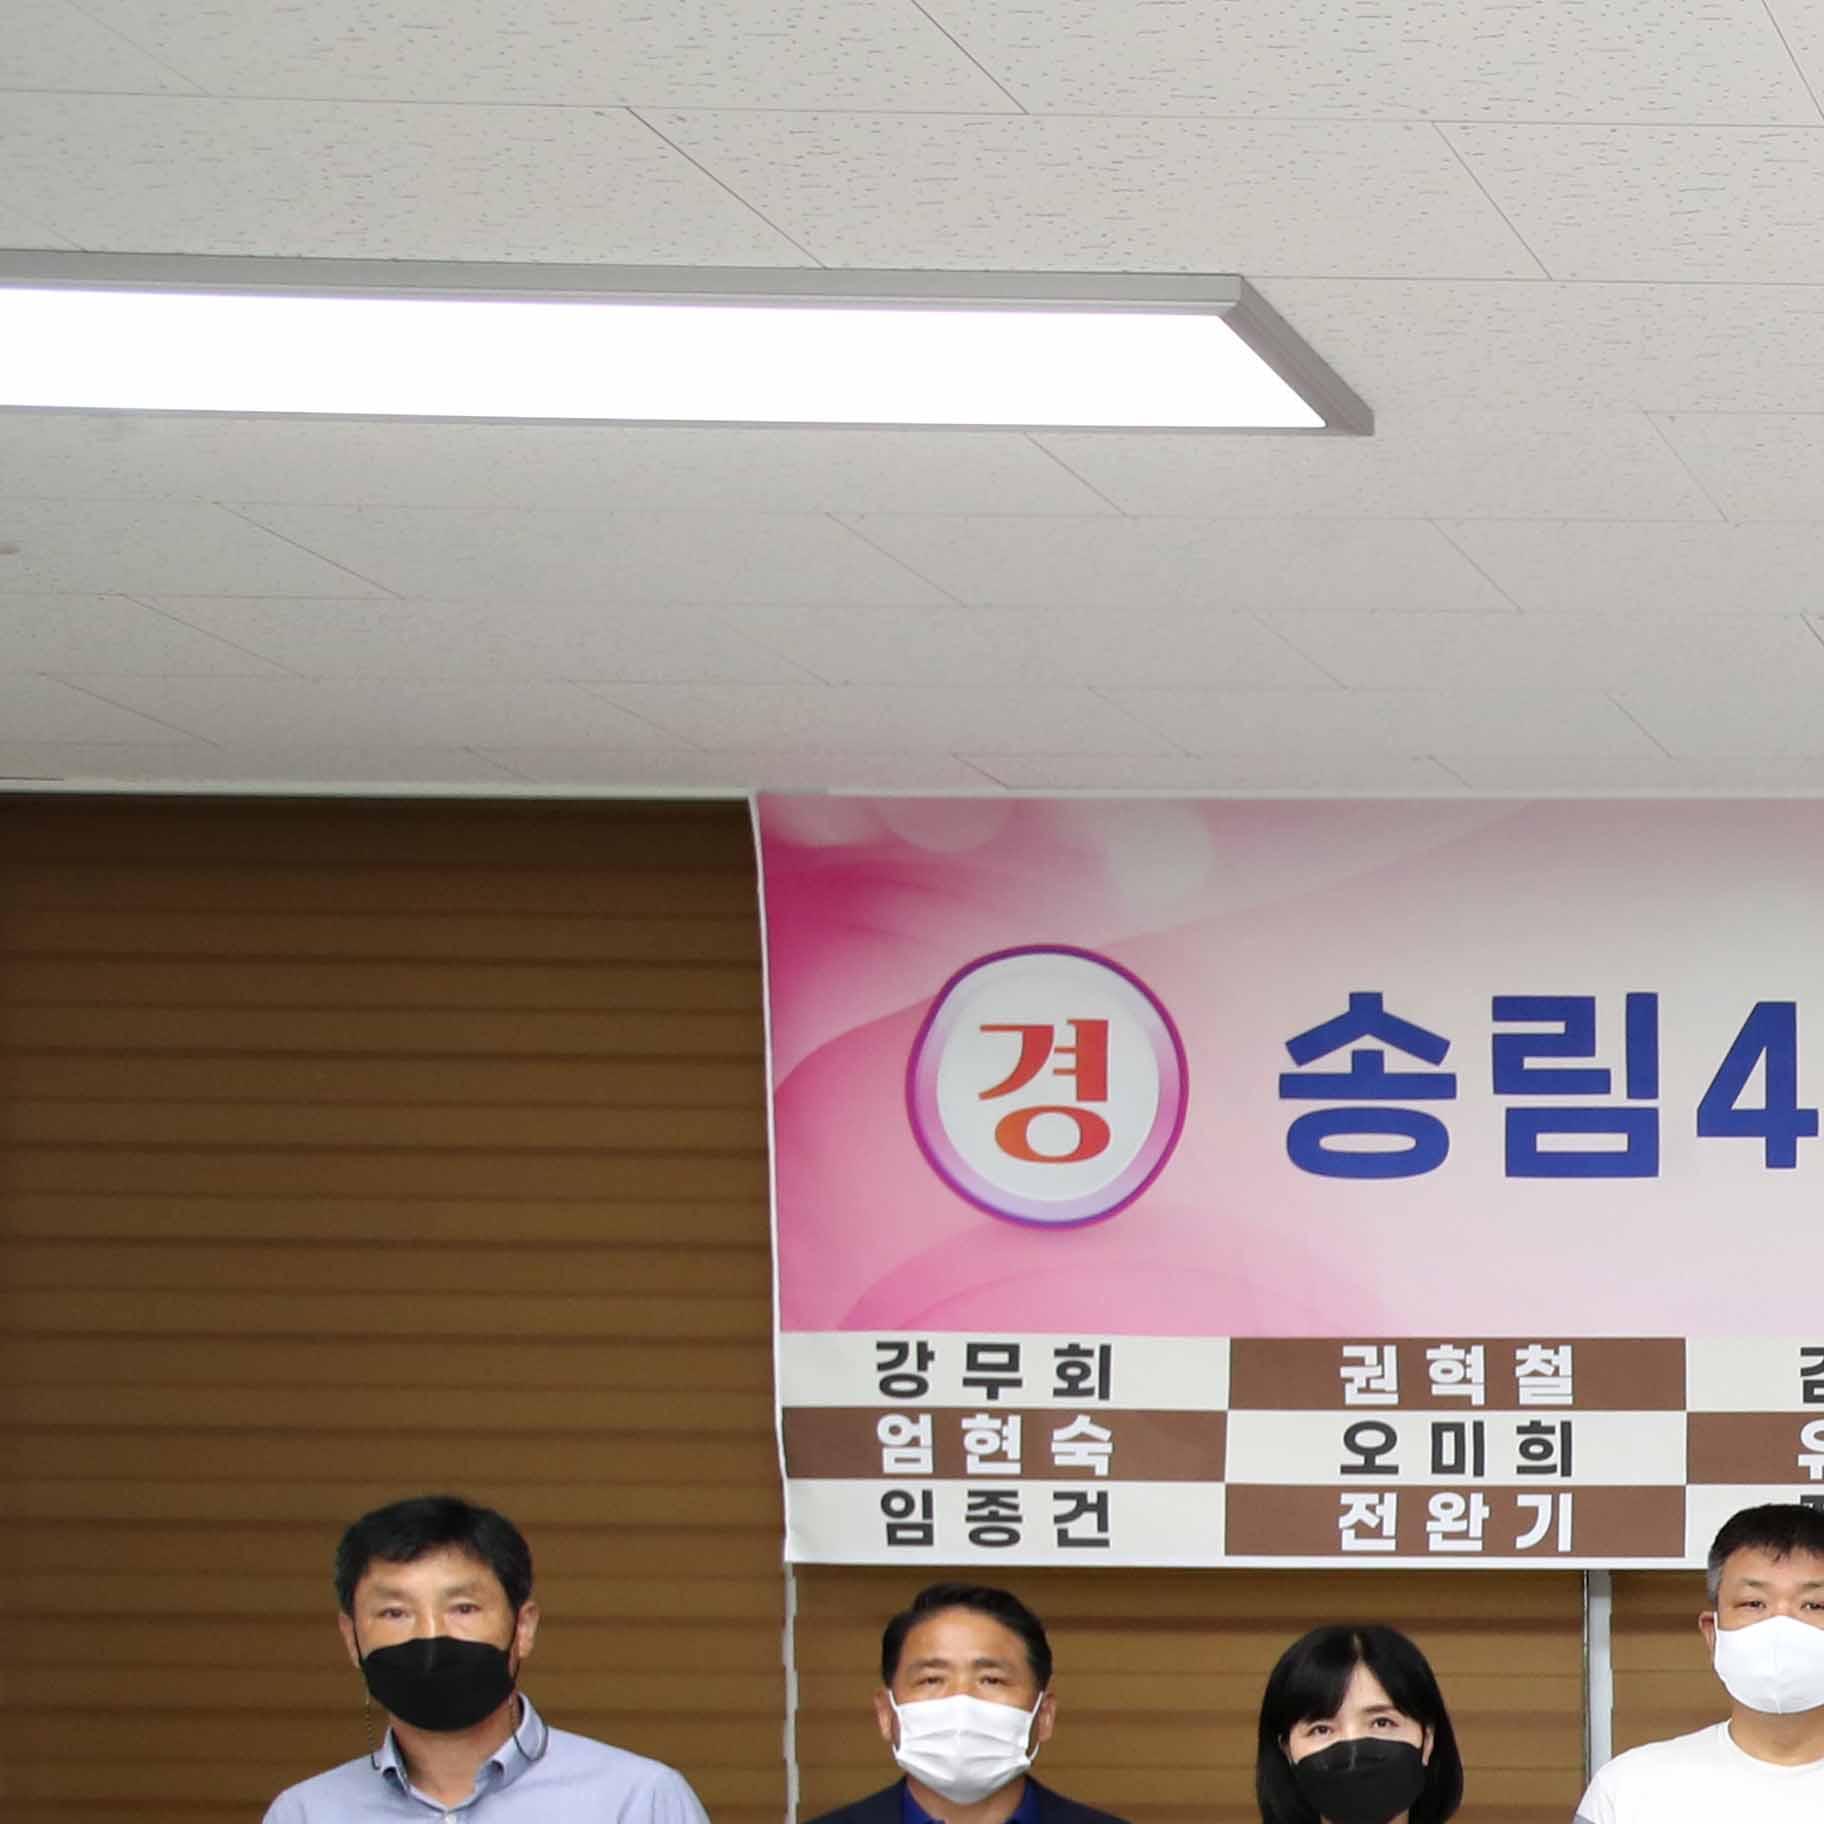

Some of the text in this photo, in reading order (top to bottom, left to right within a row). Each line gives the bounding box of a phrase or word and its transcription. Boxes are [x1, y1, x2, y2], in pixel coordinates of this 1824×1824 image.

[979, 1019, 1110, 1163] 경
[876, 1341, 1111, 1400] 강무회
[1340, 1345, 1572, 1405] 권혁철
[877, 1414, 1112, 1475] 엄현숙
[1340, 1420, 1572, 1477] 오미희
[881, 1489, 1109, 1547] 임종건
[1339, 1492, 1572, 1552] 전완기
